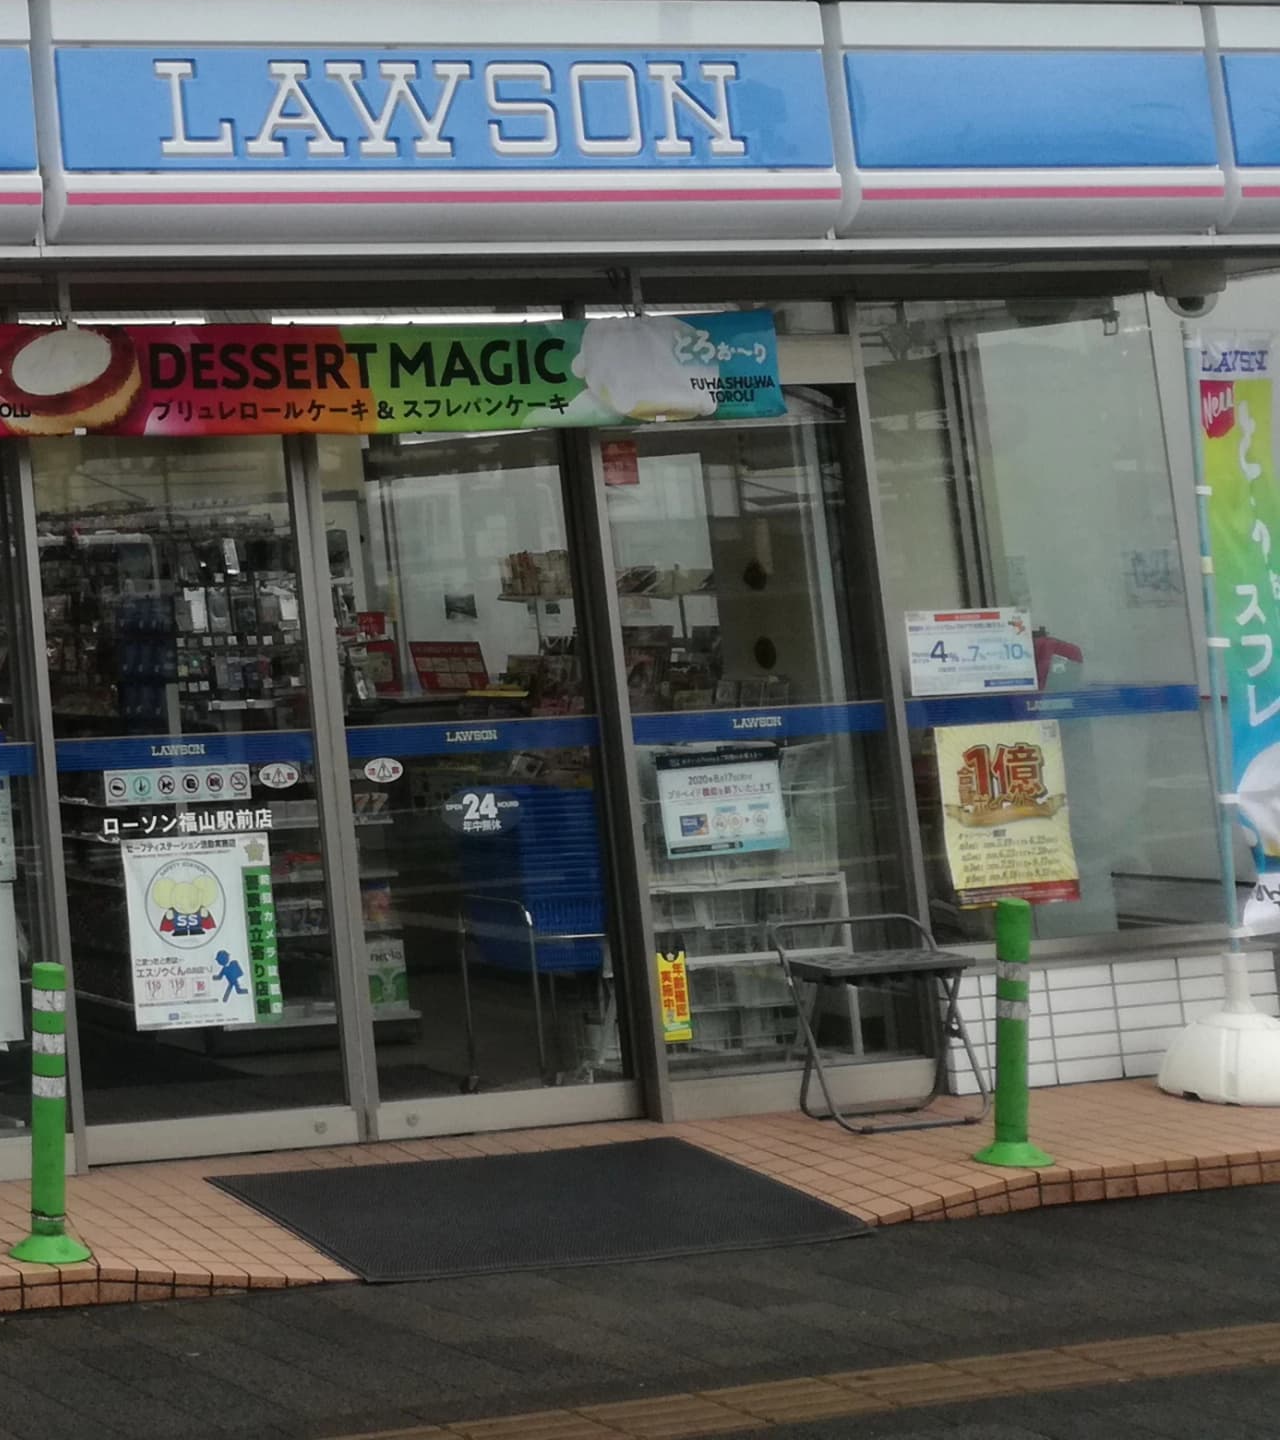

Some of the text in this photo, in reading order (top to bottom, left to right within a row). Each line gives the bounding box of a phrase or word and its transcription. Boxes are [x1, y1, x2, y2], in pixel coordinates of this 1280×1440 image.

[153, 59, 747, 160] LAWSON
[148, 337, 568, 391] DESSERT MAGIC
[152, 393, 569, 421] ブリュレロールケーキ & スフレパンケーキ
[151, 743, 206, 757] LAWSON
[445, 729, 498, 743] LAWSON
[462, 793, 499, 820] 24
[103, 808, 274, 836] ローソン福山駅前店
